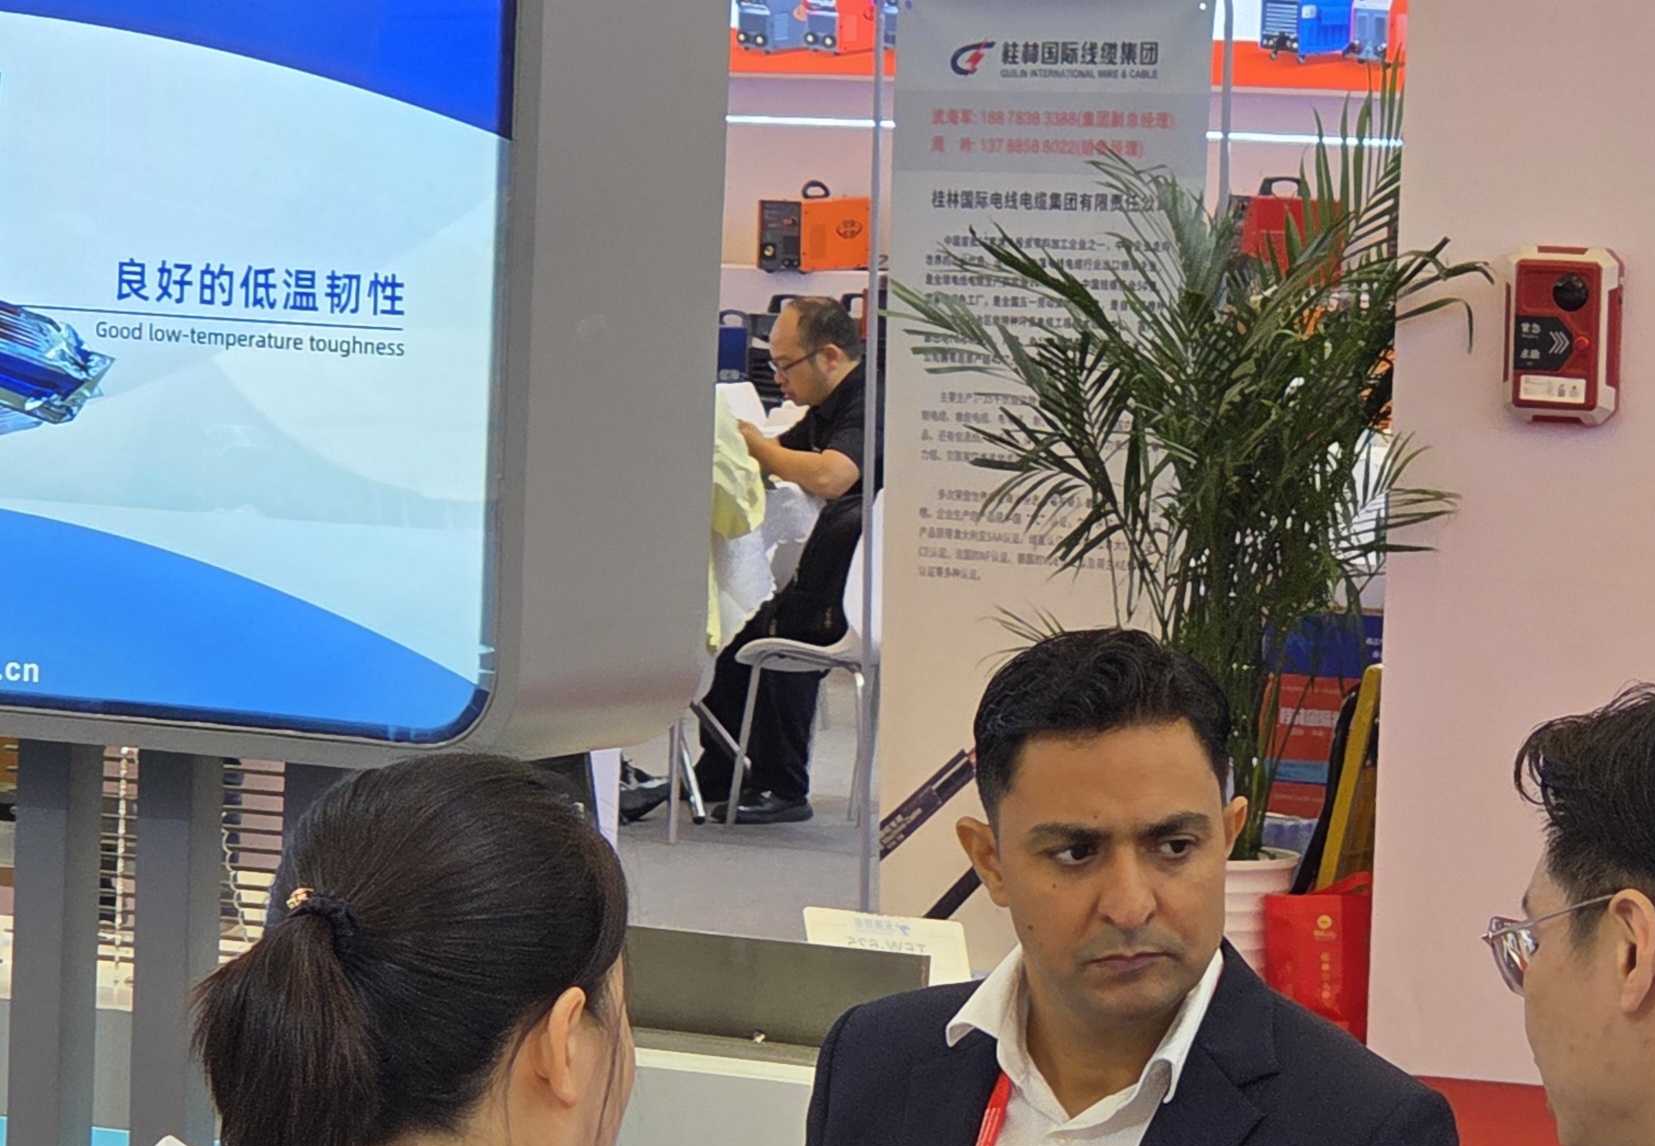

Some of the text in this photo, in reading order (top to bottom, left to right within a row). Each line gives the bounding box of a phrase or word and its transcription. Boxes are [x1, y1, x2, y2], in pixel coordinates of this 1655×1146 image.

[1001, 40, 1159, 66] 桂林国际线缆集团
[931, 189, 1164, 213] 桂林国际电线电缆集团有限责任公
[116, 257, 405, 317] 良好的低温韧性
[95, 321, 405, 358] Good low-temperature toughness
